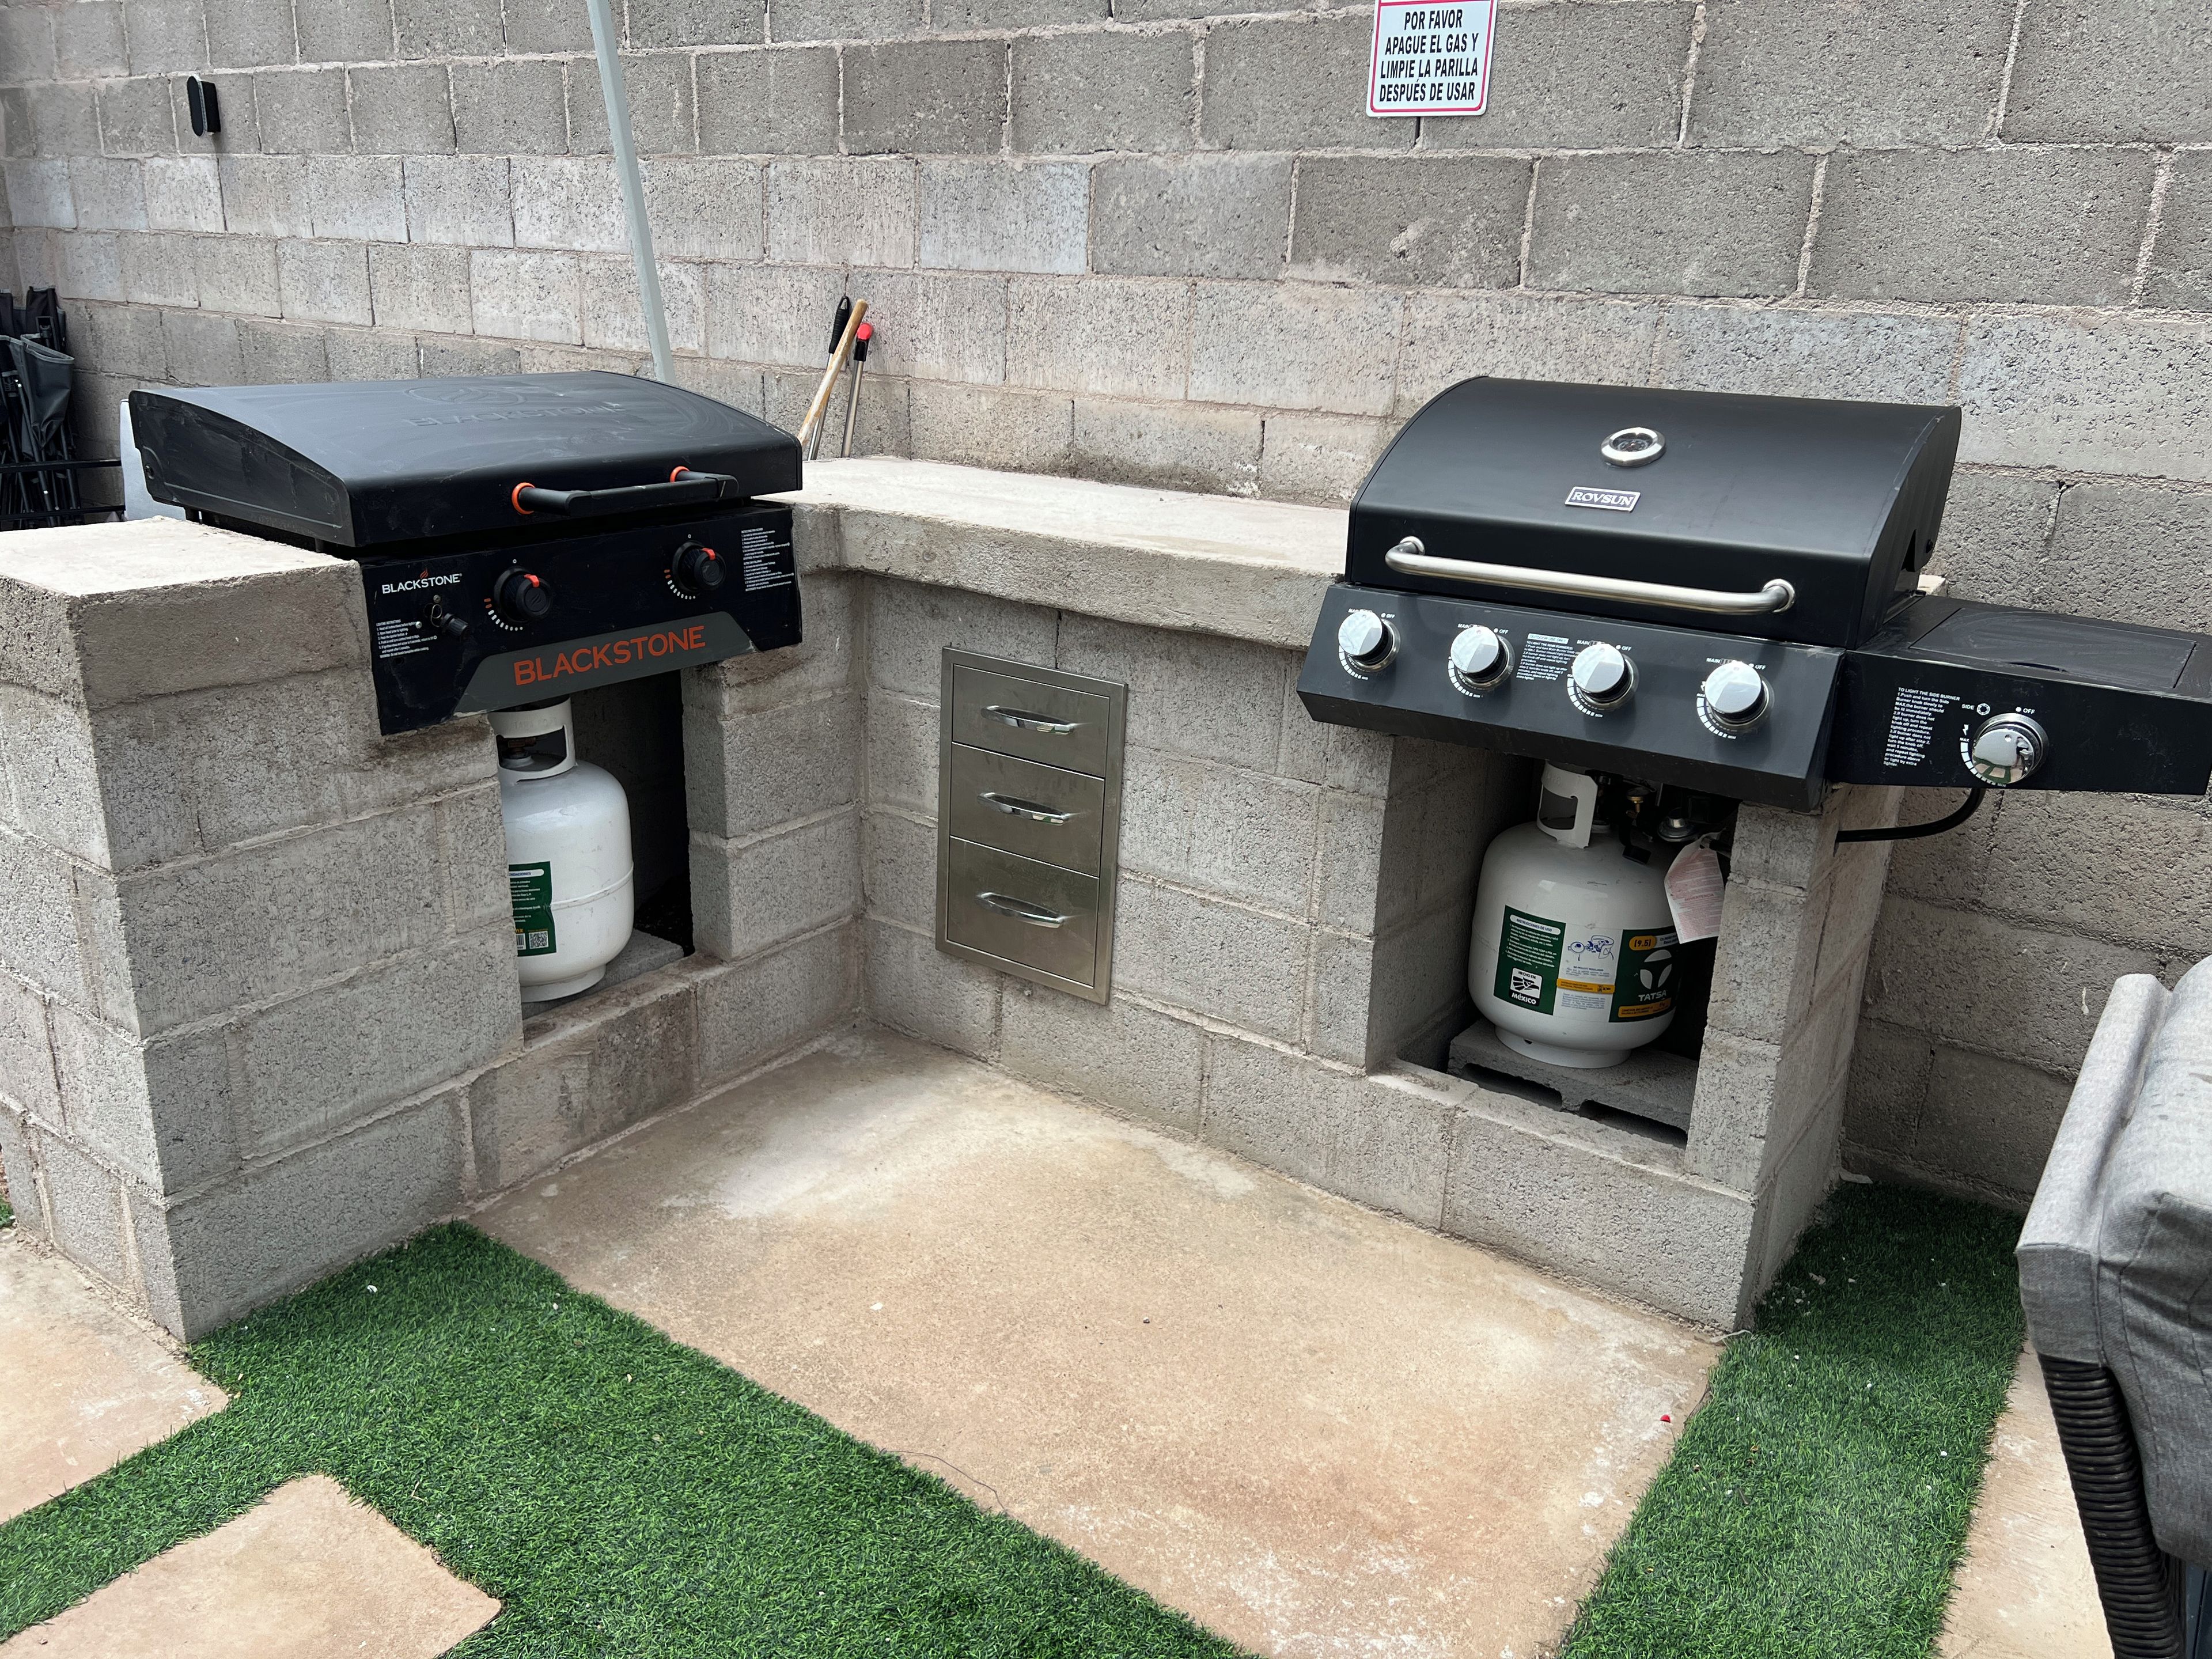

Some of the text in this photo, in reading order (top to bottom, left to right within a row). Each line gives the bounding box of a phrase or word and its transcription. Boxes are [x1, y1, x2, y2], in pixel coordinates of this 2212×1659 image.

[1404, 9, 1463, 30] POR FAVOR
[1385, 33, 1479, 55] APAGUE EL GAS Y
[1380, 57, 1478, 78] LIMPIE LA PARILLA
[1379, 79, 1475, 102] DESPUÉS DE USAR
[1571, 491, 1634, 506] ROVSUN
[381, 573, 461, 594] BLACKSTONE
[513, 625, 706, 685] BLACKSTONE
[1518, 970, 1530, 978] HECHO
[1638, 990, 1666, 1002] TATSA
